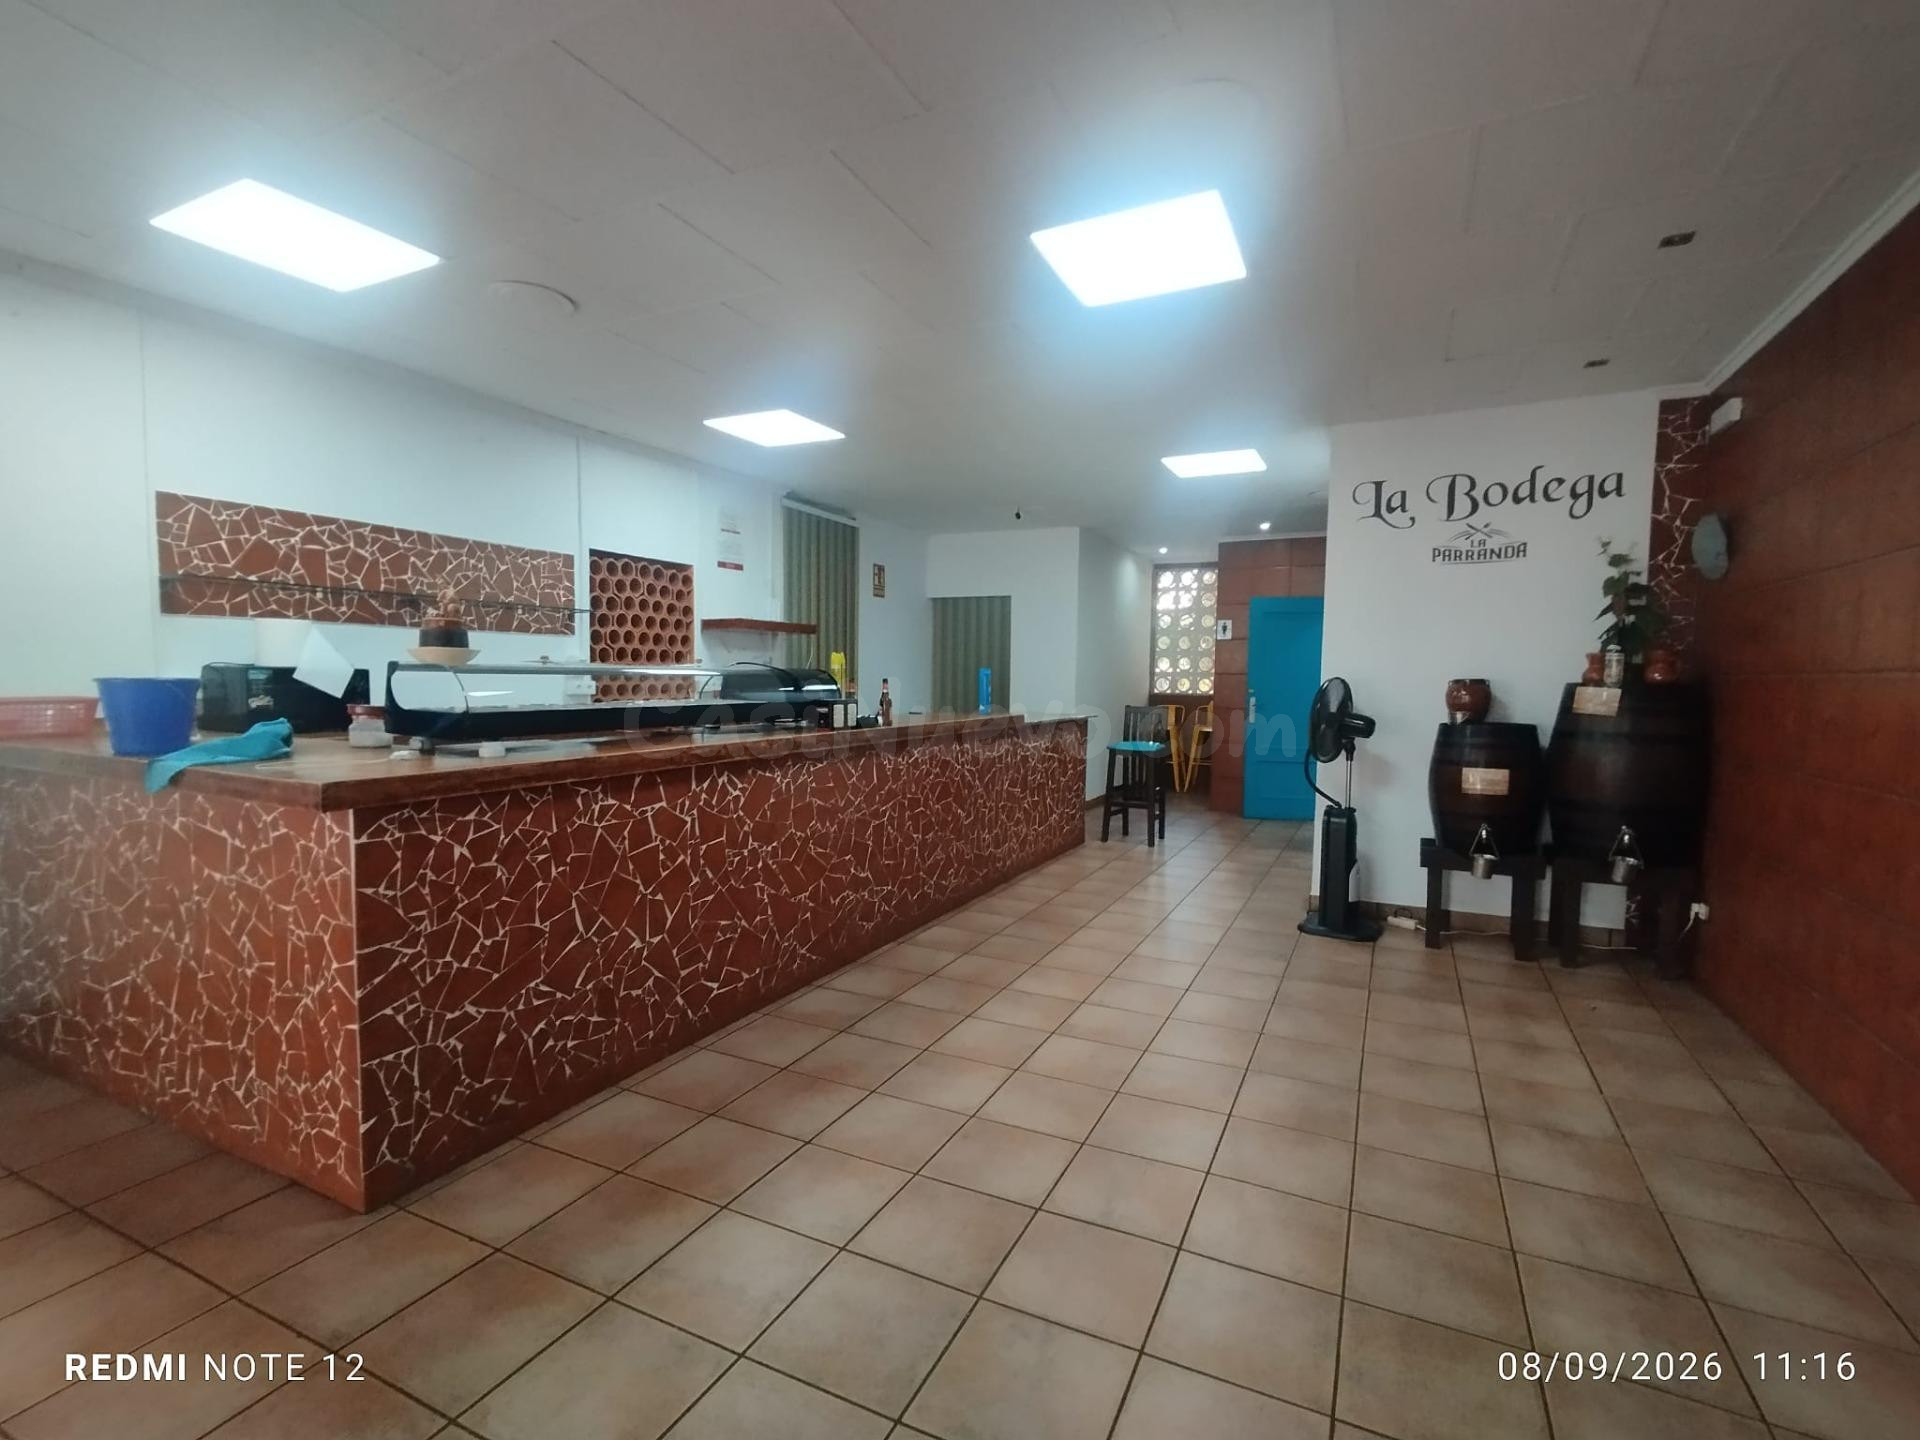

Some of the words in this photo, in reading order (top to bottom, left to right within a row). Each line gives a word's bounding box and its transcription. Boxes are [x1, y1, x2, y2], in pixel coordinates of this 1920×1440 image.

[1352, 480, 1416, 530] La
[1425, 464, 1627, 523] Bodega
[1432, 542, 1528, 563] PARRANDA
[1470, 538, 1487, 549] LA
